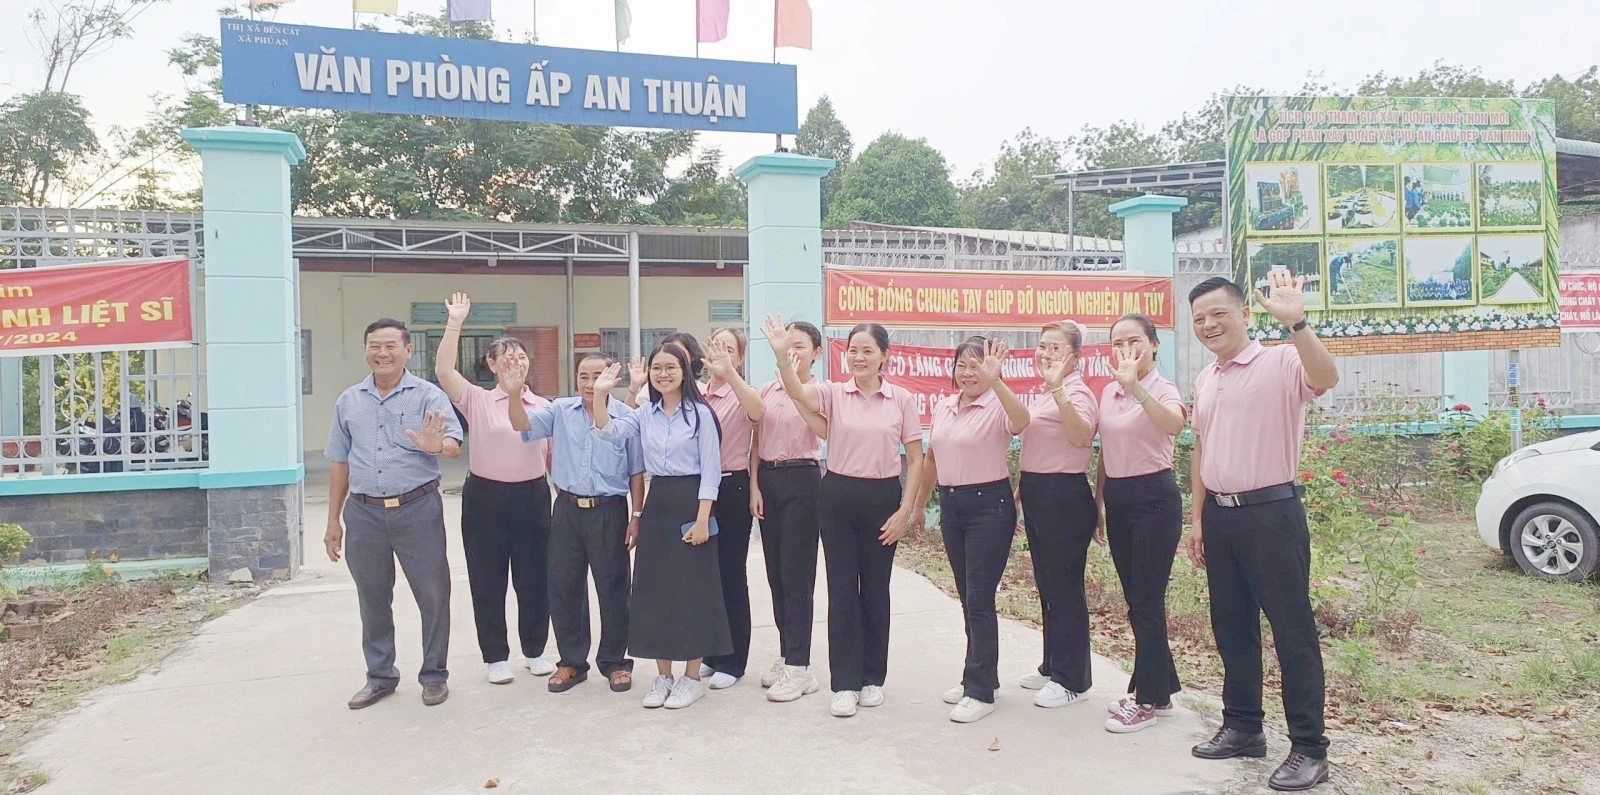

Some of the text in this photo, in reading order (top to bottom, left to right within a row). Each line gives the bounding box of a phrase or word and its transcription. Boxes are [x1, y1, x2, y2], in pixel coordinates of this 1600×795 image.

[226, 22, 244, 33] THỊ
[263, 24, 281, 34] BẾN
[282, 26, 301, 36] CÁT
[254, 35, 273, 45] PHÚ
[275, 38, 289, 46] AN
[294, 45, 747, 123] VĂN PHÒNG ẤP AN THUẬN
[1279, 108, 1302, 124] TÍCH
[1305, 109, 1326, 125] CỰC
[1328, 110, 1357, 124] THAM
[1360, 110, 1377, 124] GIA
[1490, 109, 1510, 125] MỚI
[1269, 126, 1290, 143] GÓP
[1418, 129, 1432, 143] AN
[1502, 129, 1529, 143] MINH
[838, 279, 1165, 321] CỘNG ĐỒNG CHUNG TAY GIÚP ĐỠ NGƯỜI NGHIỆN MA TÚY
[1560, 295, 1577, 306] HÒNG
[1578, 295, 1596, 306] CHÁY
[62, 299, 129, 328] LIỆT
[140, 296, 174, 322] SĨ
[0, 331, 78, 346] /2024
[888, 351, 906, 377] CÓ
[909, 352, 943, 377] LĂNG
[1000, 354, 1036, 378] HÔNG
